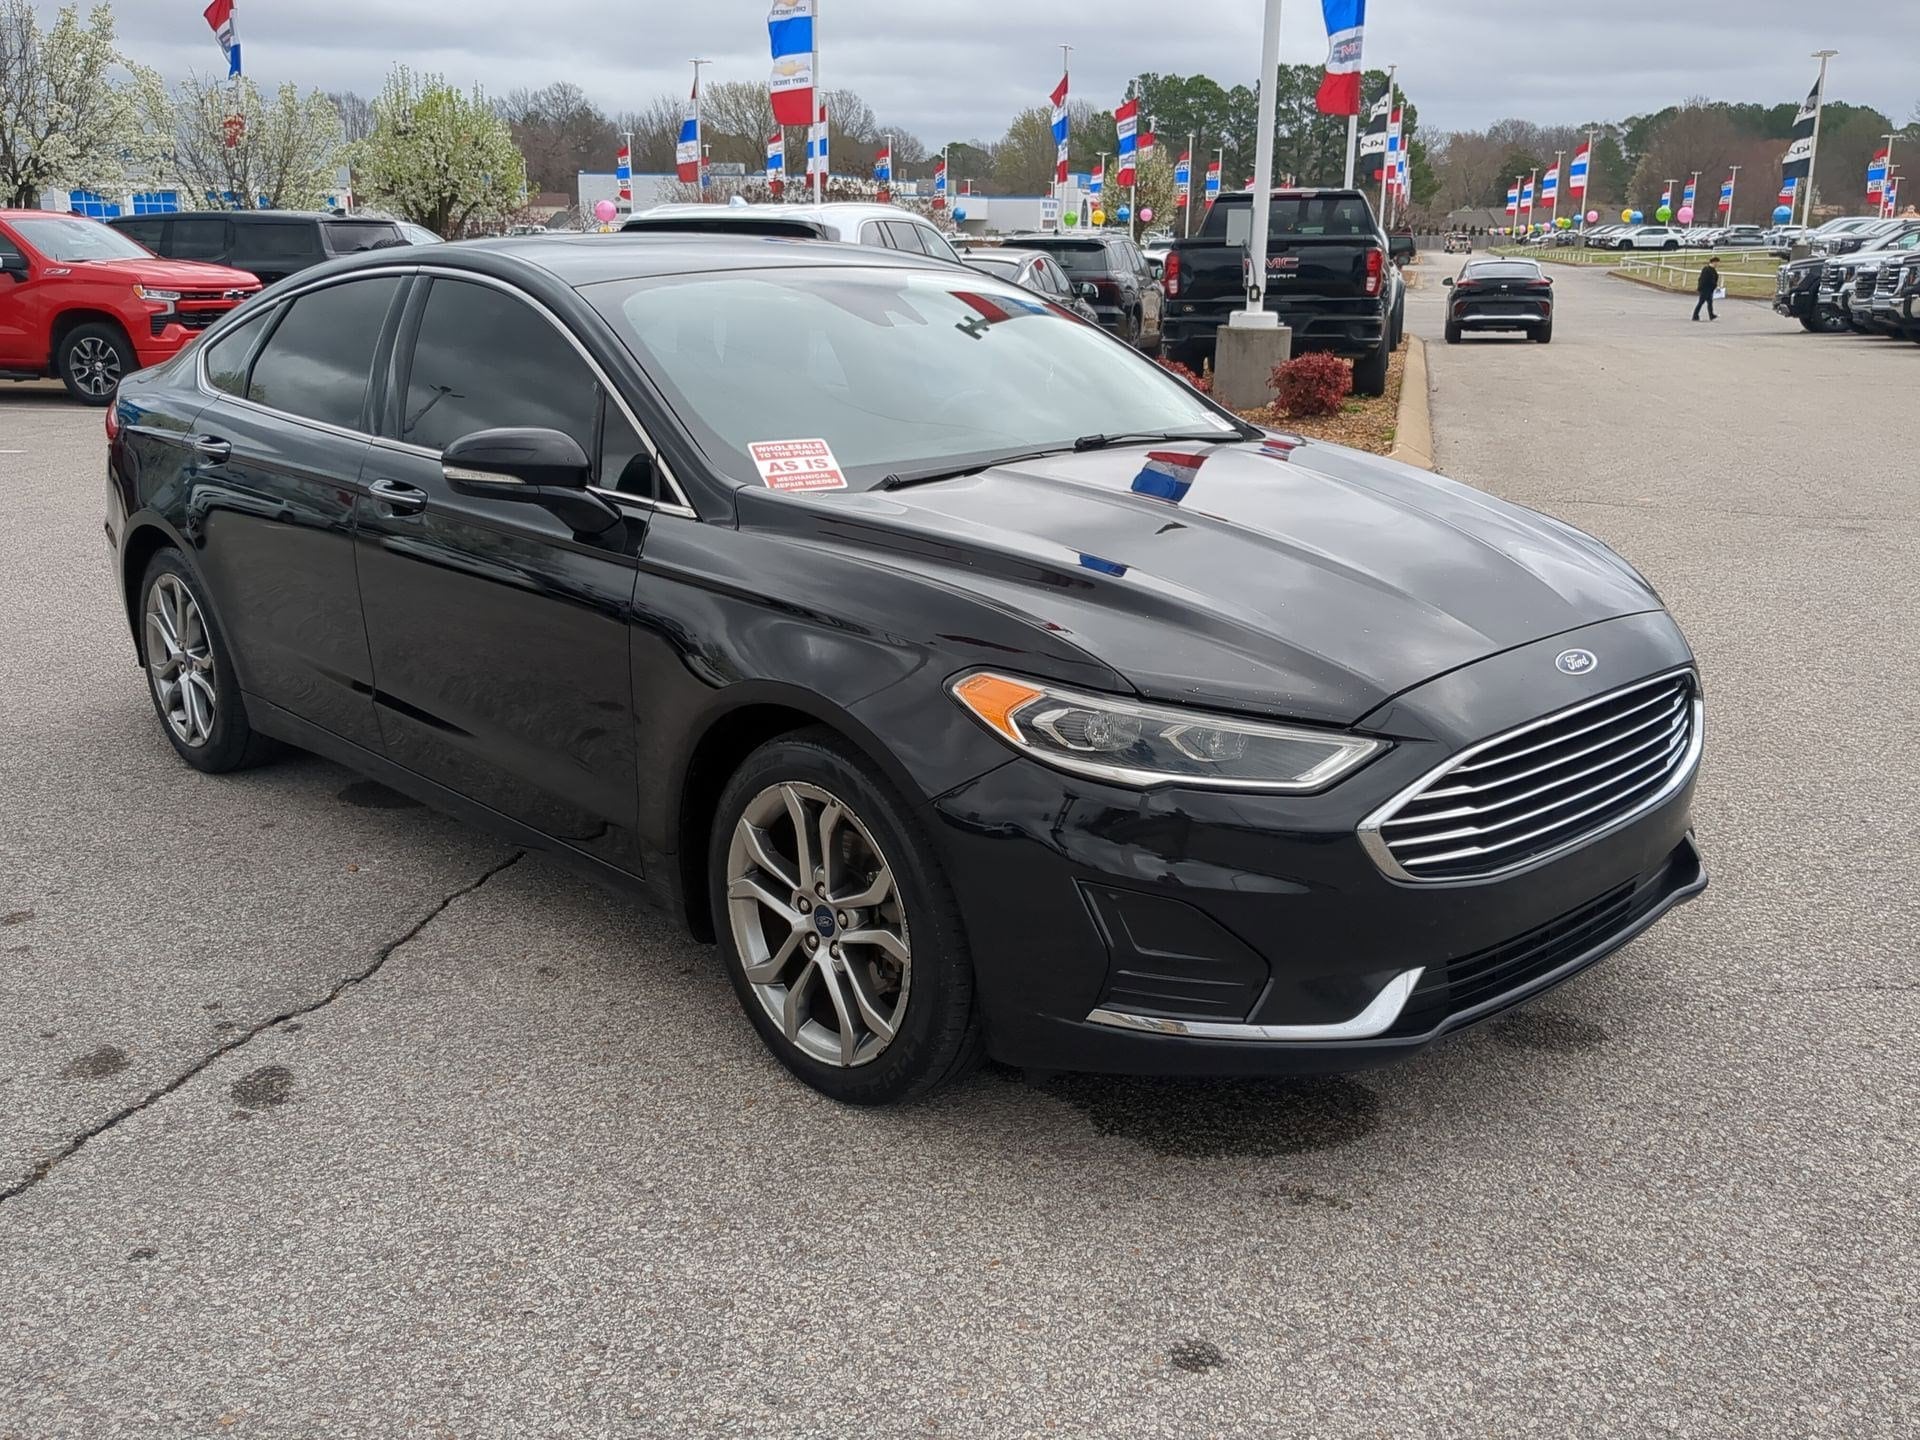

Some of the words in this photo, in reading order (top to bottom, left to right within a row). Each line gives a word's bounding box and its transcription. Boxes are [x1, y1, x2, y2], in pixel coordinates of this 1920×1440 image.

[756, 441, 823, 453] WHOLESALE
[774, 450, 792, 458] THE
[794, 449, 826, 457] PUBLIC
[769, 460, 799, 473] AS
[806, 458, 829, 469] IS
[776, 473, 831, 482] MECHANICAL
[773, 481, 804, 489] REPAIR
[806, 478, 838, 487] NEEDED
[1564, 653, 1590, 671] Ford
